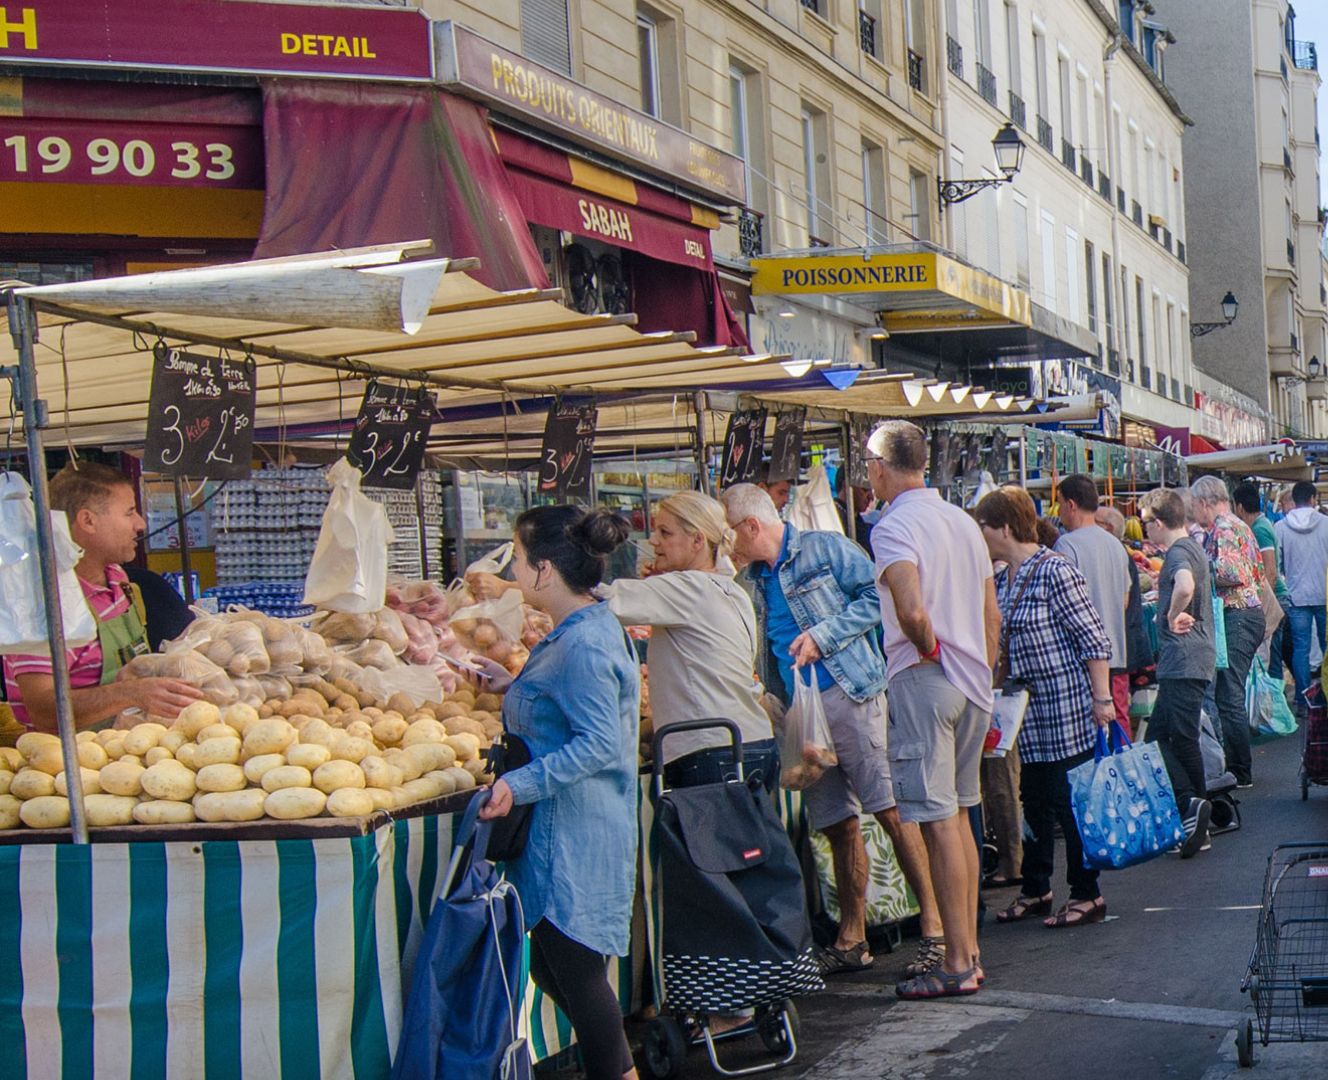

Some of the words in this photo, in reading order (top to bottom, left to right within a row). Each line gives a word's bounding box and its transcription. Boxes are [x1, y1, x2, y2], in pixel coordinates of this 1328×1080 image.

[0, 7, 38, 50] H
[281, 33, 376, 58] DETAIL
[490, 53, 577, 125] PRODUITS
[578, 95, 660, 160] ORIENTAUX
[4, 135, 72, 174] 19
[86, 138, 156, 178] 90
[170, 141, 236, 181] 33
[578, 199, 633, 243] SABAH
[684, 239, 706, 260] DETAIL
[782, 265, 928, 287] POISSONNERIE
[200, 360, 215, 377] de
[161, 405, 184, 465] 3
[362, 431, 379, 478] 3
[541, 448, 558, 483] 3
